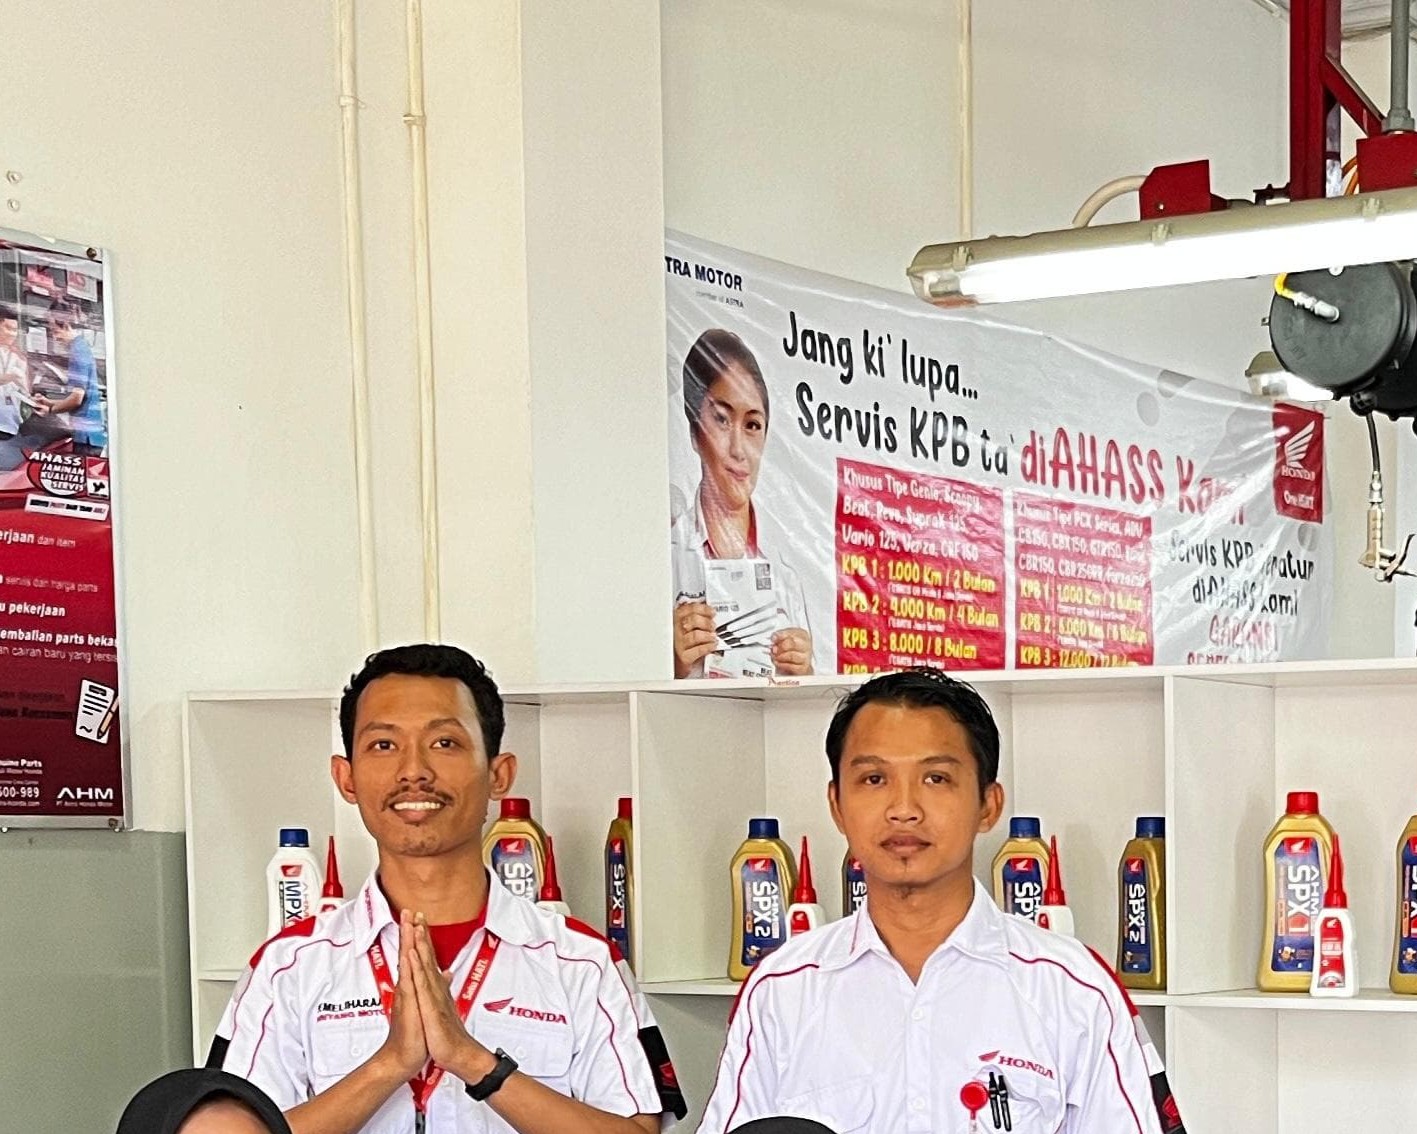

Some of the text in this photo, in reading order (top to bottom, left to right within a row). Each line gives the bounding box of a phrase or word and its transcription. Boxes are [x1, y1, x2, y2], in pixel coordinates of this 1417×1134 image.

[695, 264, 743, 292] MOTOR
[783, 311, 852, 385] Jang
[796, 381, 898, 454] Servis
[911, 406, 971, 469] KPB
[1020, 427, 1166, 505] diAHASS
[41, 471, 85, 484] KUALITAS
[841, 553, 868, 577] KPB
[887, 560, 920, 583] 1.000
[923, 564, 943, 587] Km
[963, 570, 996, 594] Bulan
[8, 601, 66, 618] pekerjaan
[843, 590, 869, 613] KPB
[926, 601, 946, 622] Km
[967, 605, 999, 628] Bulan
[55, 633, 85, 646] parts
[843, 627, 868, 649] KPB
[872, 629, 880, 651] 3
[889, 632, 924, 654] 8.000
[934, 637, 942, 657] 8
[944, 637, 977, 660] Bulan
[1020, 645, 1041, 665] KPB
[57, 787, 114, 801] AHM
[508, 1005, 568, 1025] HONDA
[999, 1055, 1055, 1081] HONDA
